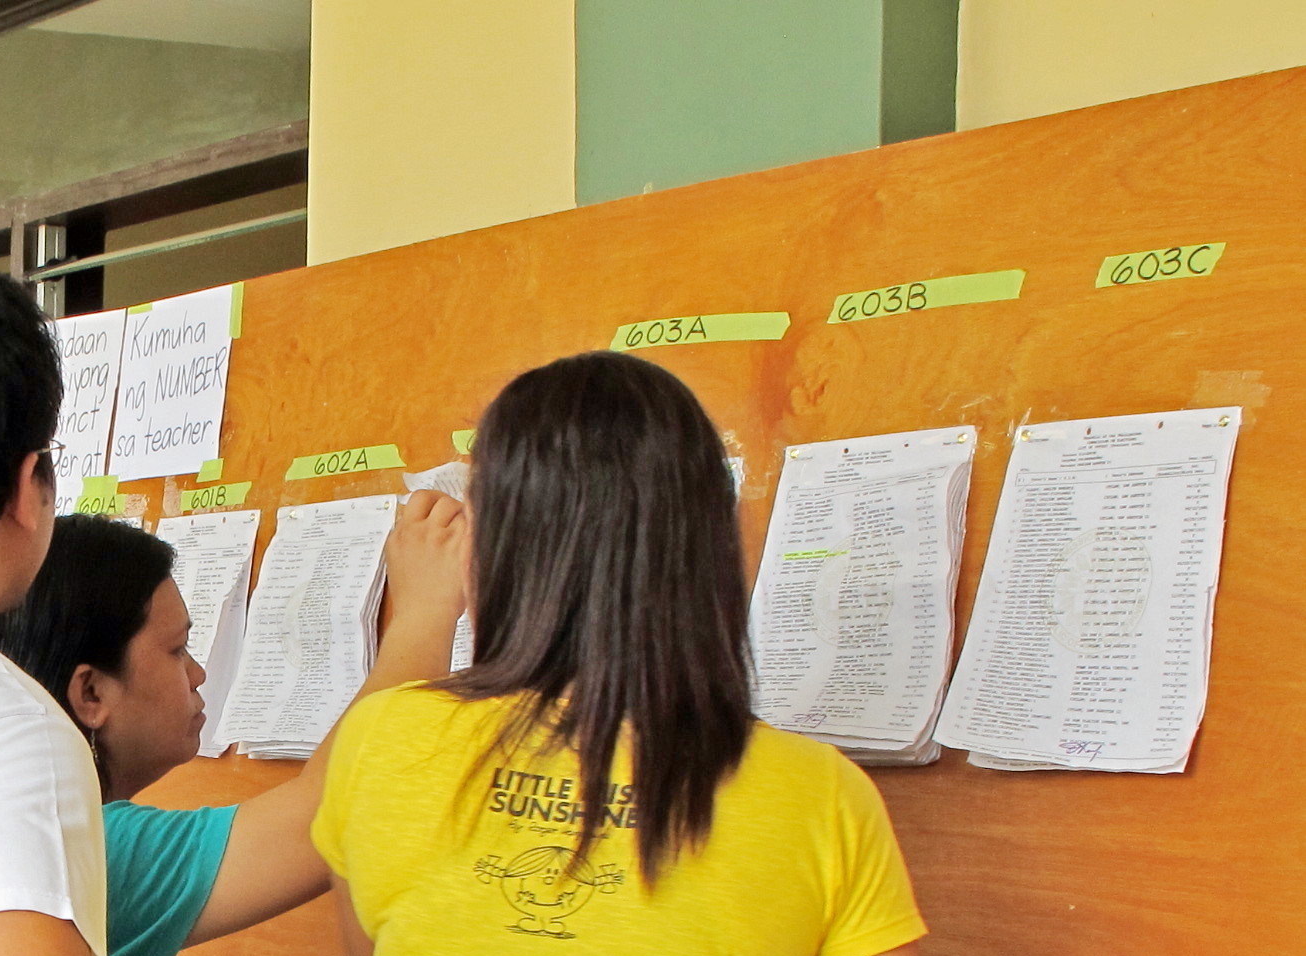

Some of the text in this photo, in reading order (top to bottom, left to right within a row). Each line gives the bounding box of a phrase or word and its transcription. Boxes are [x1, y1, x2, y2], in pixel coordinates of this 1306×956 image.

[1110, 245, 1211, 285] 603C
[837, 282, 928, 322] 603B
[130, 310, 206, 361] Kumuha
[625, 315, 707, 348] 603A
[124, 346, 228, 422] ng NUMBER
[114, 412, 215, 458] sa teacher.
[81, 440, 102, 477] at
[314, 449, 369, 475] 602A
[79, 495, 117, 514] 601A
[191, 485, 227, 509] 601B
[491, 767, 574, 800] LITTLE
[489, 790, 639, 829] SUNSHNE
